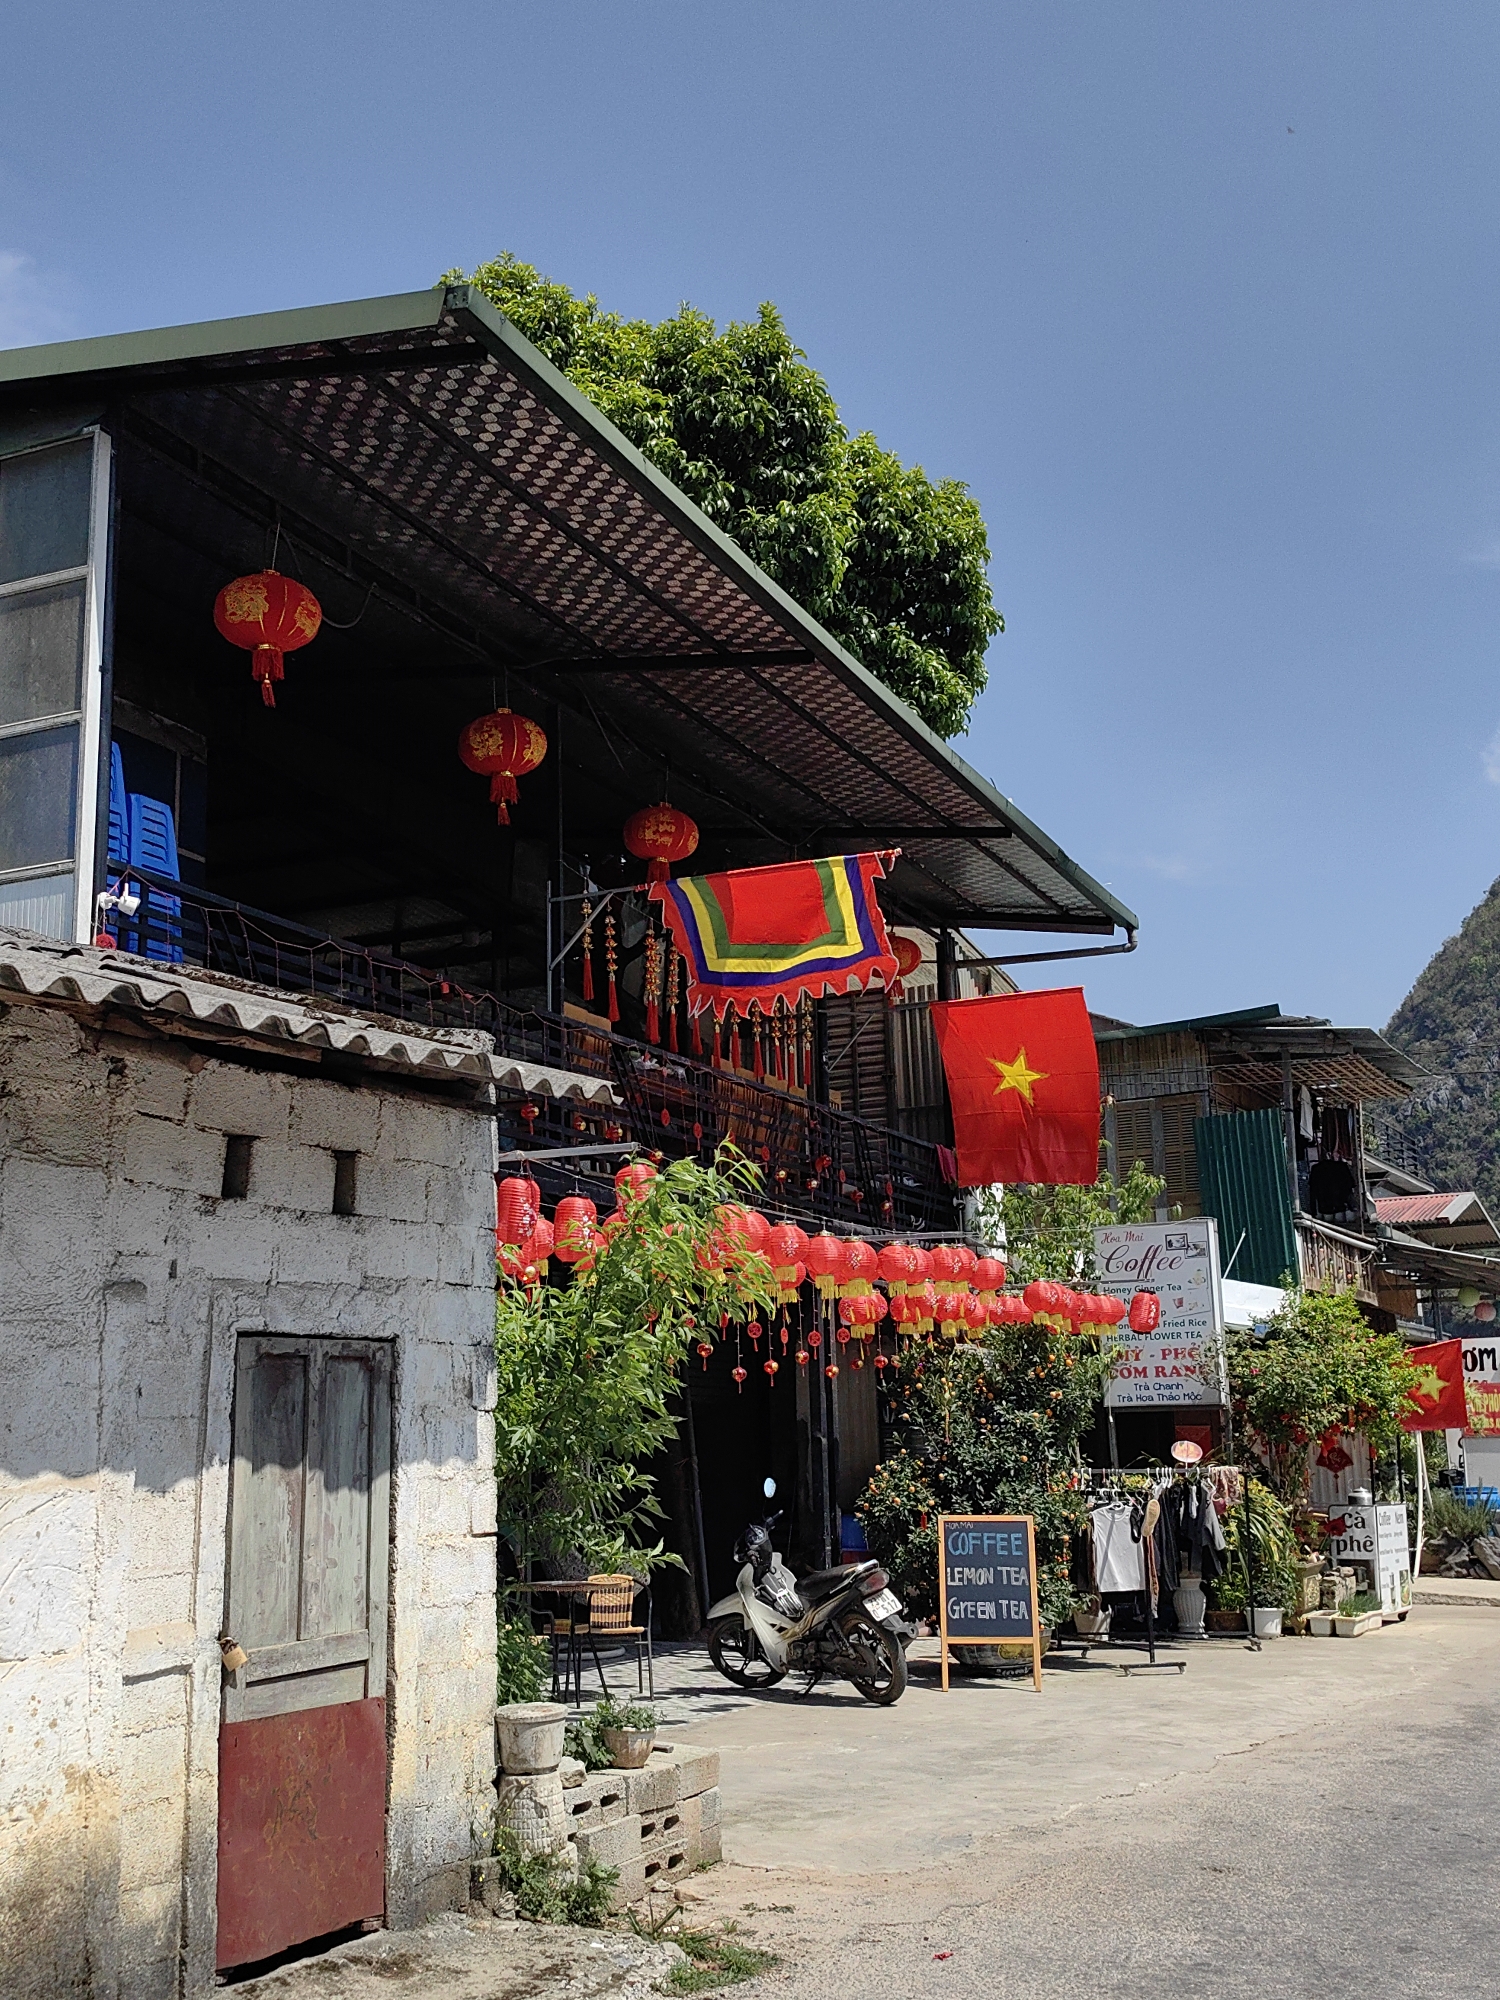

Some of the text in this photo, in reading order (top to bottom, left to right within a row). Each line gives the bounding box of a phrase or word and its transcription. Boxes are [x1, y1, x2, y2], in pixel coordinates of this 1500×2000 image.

[1101, 1230, 1144, 1244] Hoa Mai
[1100, 1244, 1184, 1280] Coffee
[1166, 1283, 1182, 1291] Tea
[1163, 1320, 1186, 1328] Fried
[1188, 1318, 1207, 1327] Rice
[1185, 1330, 1203, 1339] TEA
[1462, 1346, 1498, 1372] ƠM
[1152, 1382, 1184, 1391] Chanh
[1341, 1511, 1366, 1530] Cà
[947, 1531, 1023, 1556] COFFEE
[1334, 1534, 1374, 1556] phê
[946, 1566, 1029, 1586] LEMON TEA
[999, 1599, 1029, 1620] TEA
